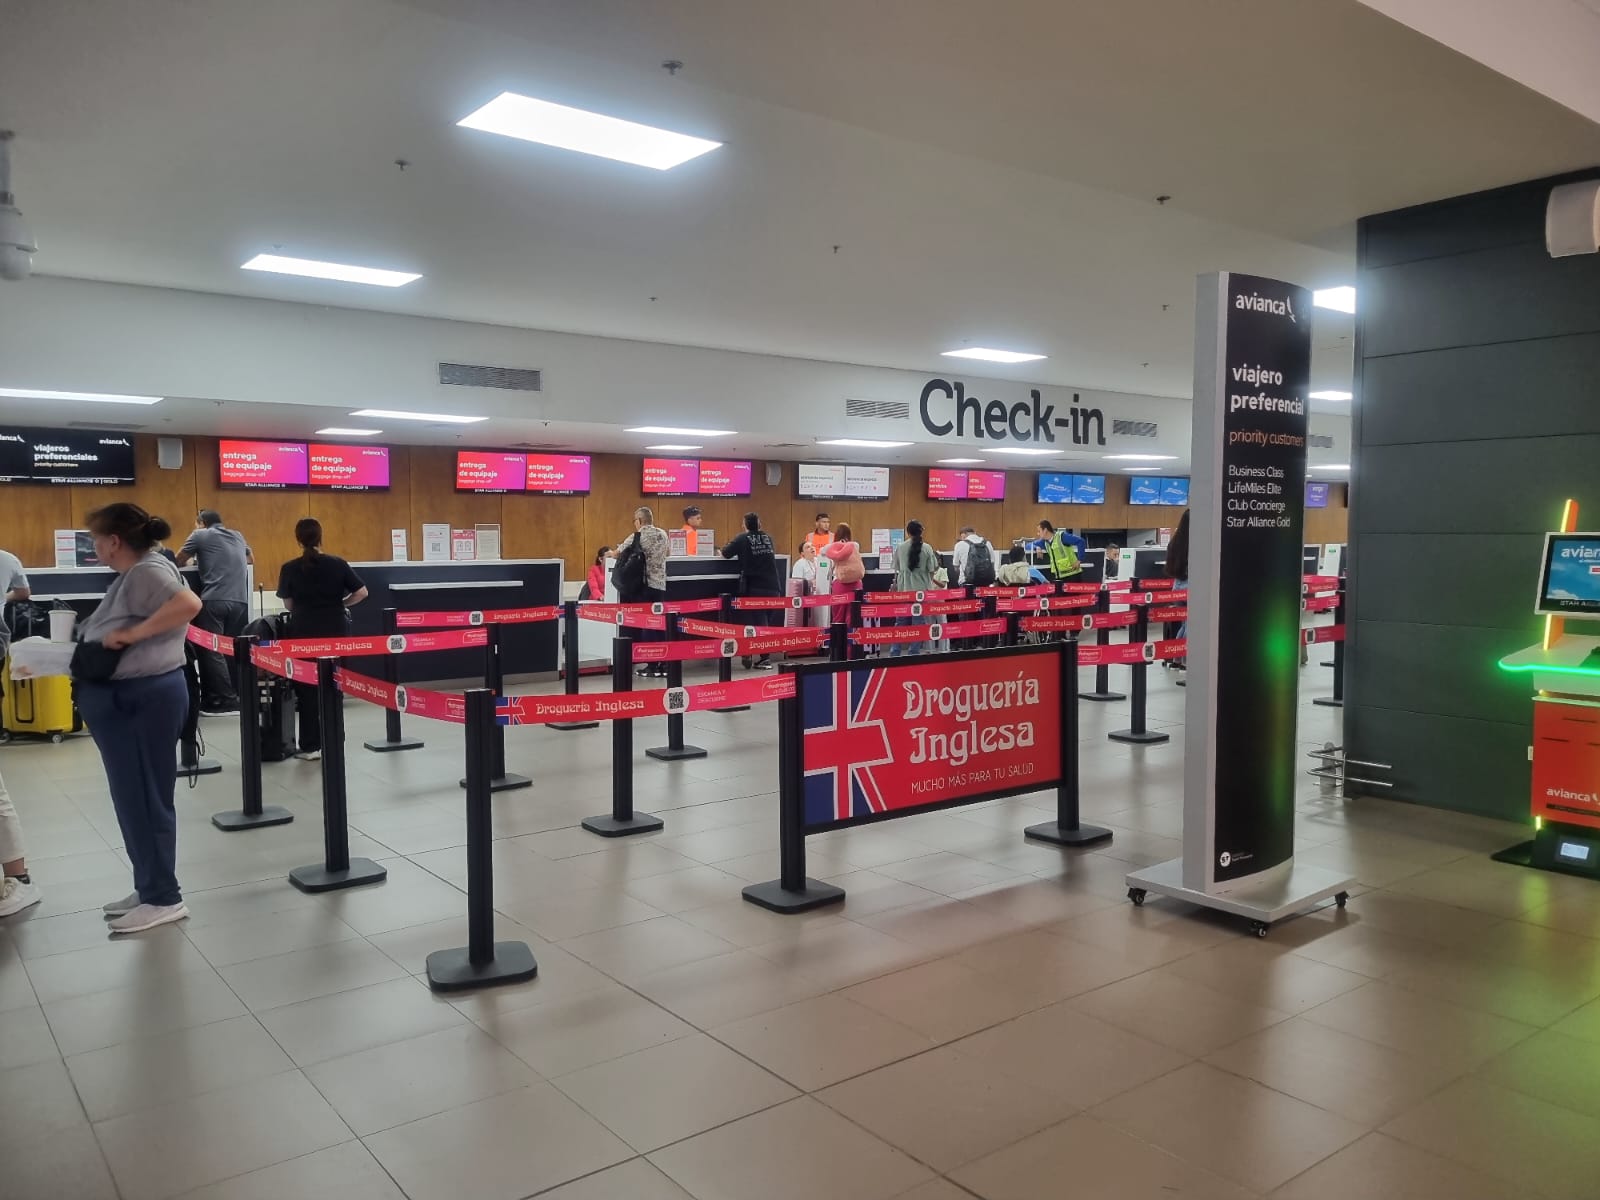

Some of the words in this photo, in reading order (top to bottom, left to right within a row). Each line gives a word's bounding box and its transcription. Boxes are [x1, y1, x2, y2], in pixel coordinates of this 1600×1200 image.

[1236, 292, 1285, 315] avianca
[1232, 363, 1282, 387] viajero
[1231, 392, 1304, 416] preferencial
[919, 378, 1106, 446] Check-in
[1230, 428, 1268, 447] priority
[34, 444, 70, 453] viajeros
[223, 452, 257, 460] entrega
[312, 456, 342, 464] entrega
[223, 462, 234, 470] de
[236, 462, 272, 471] equipaje
[323, 465, 356, 474] equipaje
[460, 462, 486, 470] entrega
[1228, 464, 1265, 477] Business
[1266, 466, 1284, 478] Class
[469, 470, 498, 478] equipaje
[538, 472, 564, 480] equipaje
[1228, 482, 1266, 494] LifeMiles
[1267, 482, 1282, 494] Elite
[1228, 498, 1248, 510] Club
[1250, 500, 1286, 513] Concierge
[1227, 516, 1246, 528] Star
[1247, 516, 1275, 528] Alliance
[1276, 517, 1290, 528] Gold
[902, 670, 1040, 722] Droguería
[536, 702, 590, 716] Droguería
[595, 700, 644, 714] Inglesa
[910, 720, 1034, 766] Inglesa
[912, 777, 944, 794] MUCHO
[970, 770, 992, 783] PARA
[994, 768, 1006, 779] TU
[1008, 762, 1034, 777] SALUD
[1546, 788, 1590, 802] avianca
